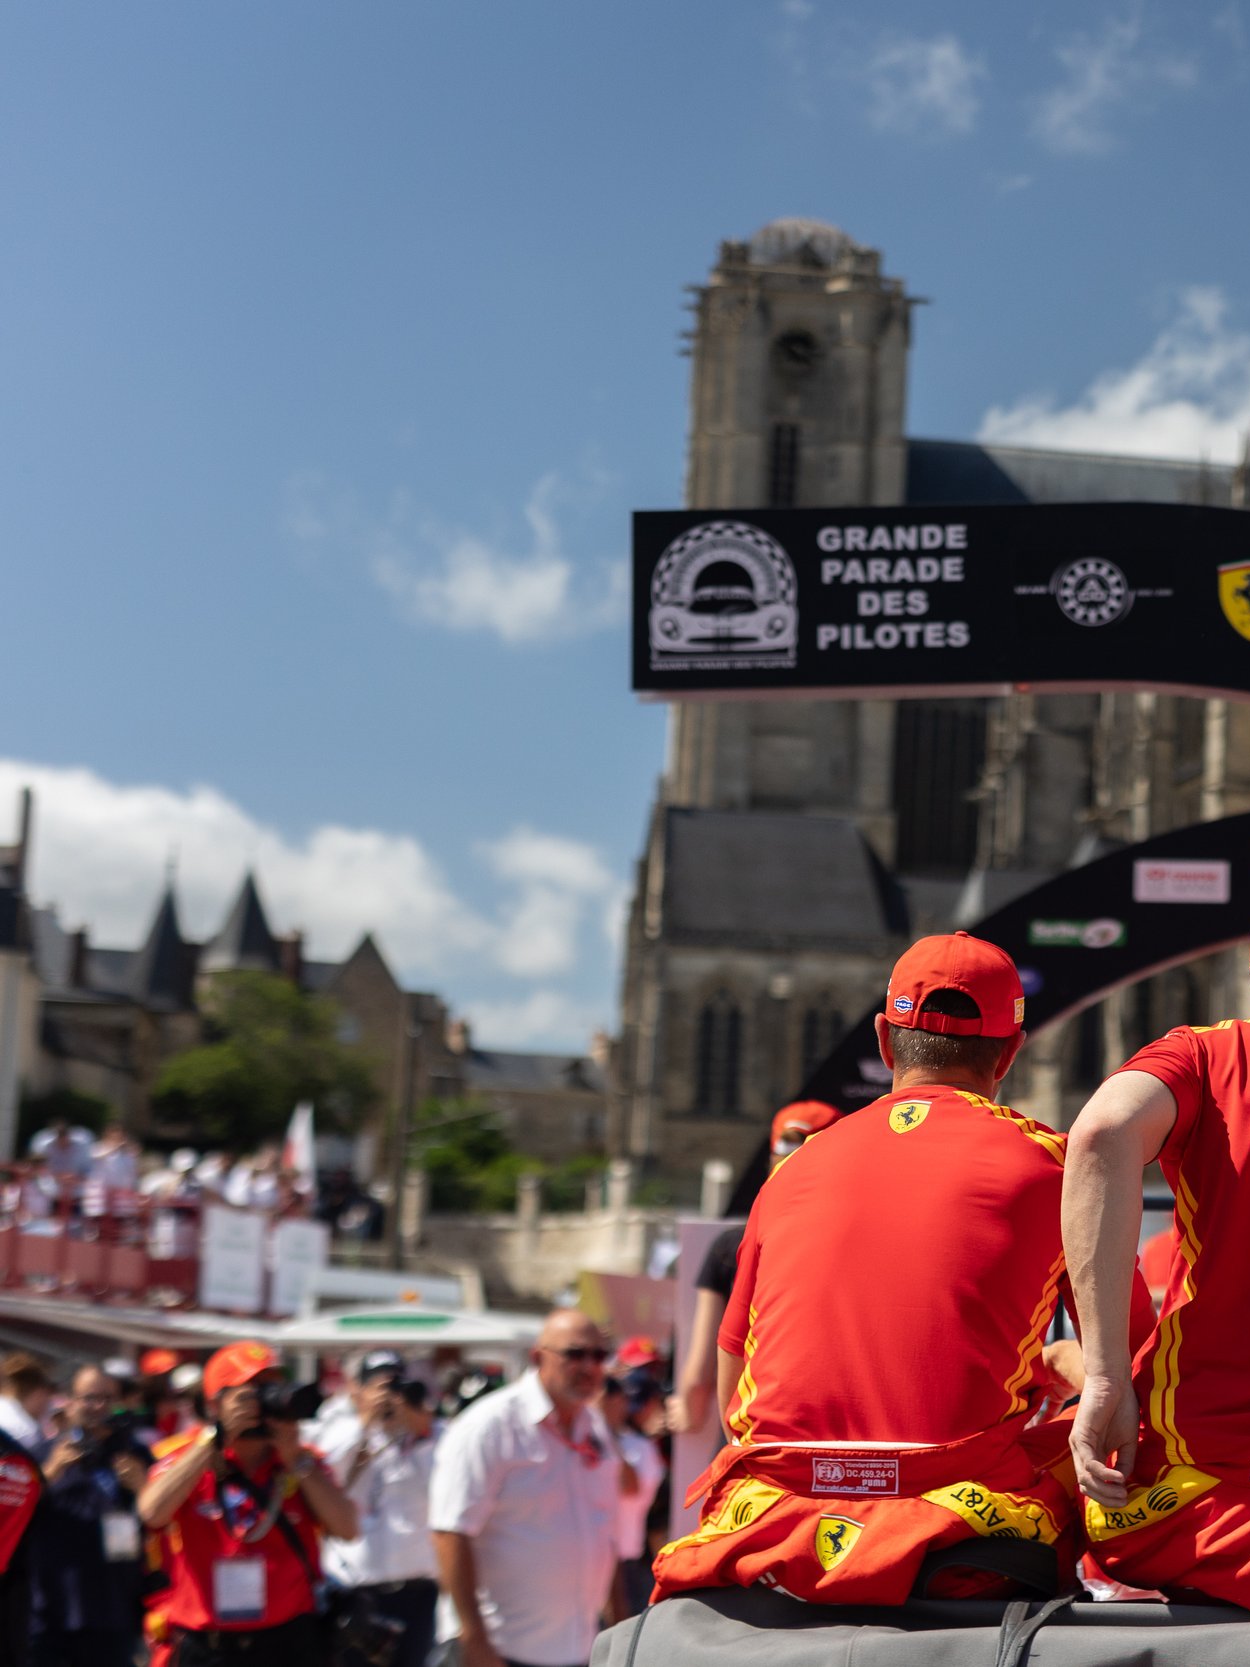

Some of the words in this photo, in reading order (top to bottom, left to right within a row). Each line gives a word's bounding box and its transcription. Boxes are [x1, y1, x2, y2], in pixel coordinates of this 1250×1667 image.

[816, 524, 968, 552] GRANDE
[820, 556, 965, 585] PARADE
[857, 589, 930, 617] DES
[816, 621, 971, 650] PILOTES
[862, 1479, 887, 1487] PUMA
[950, 1487, 1006, 1528] AT&T
[1104, 1507, 1147, 1530] AT&T
